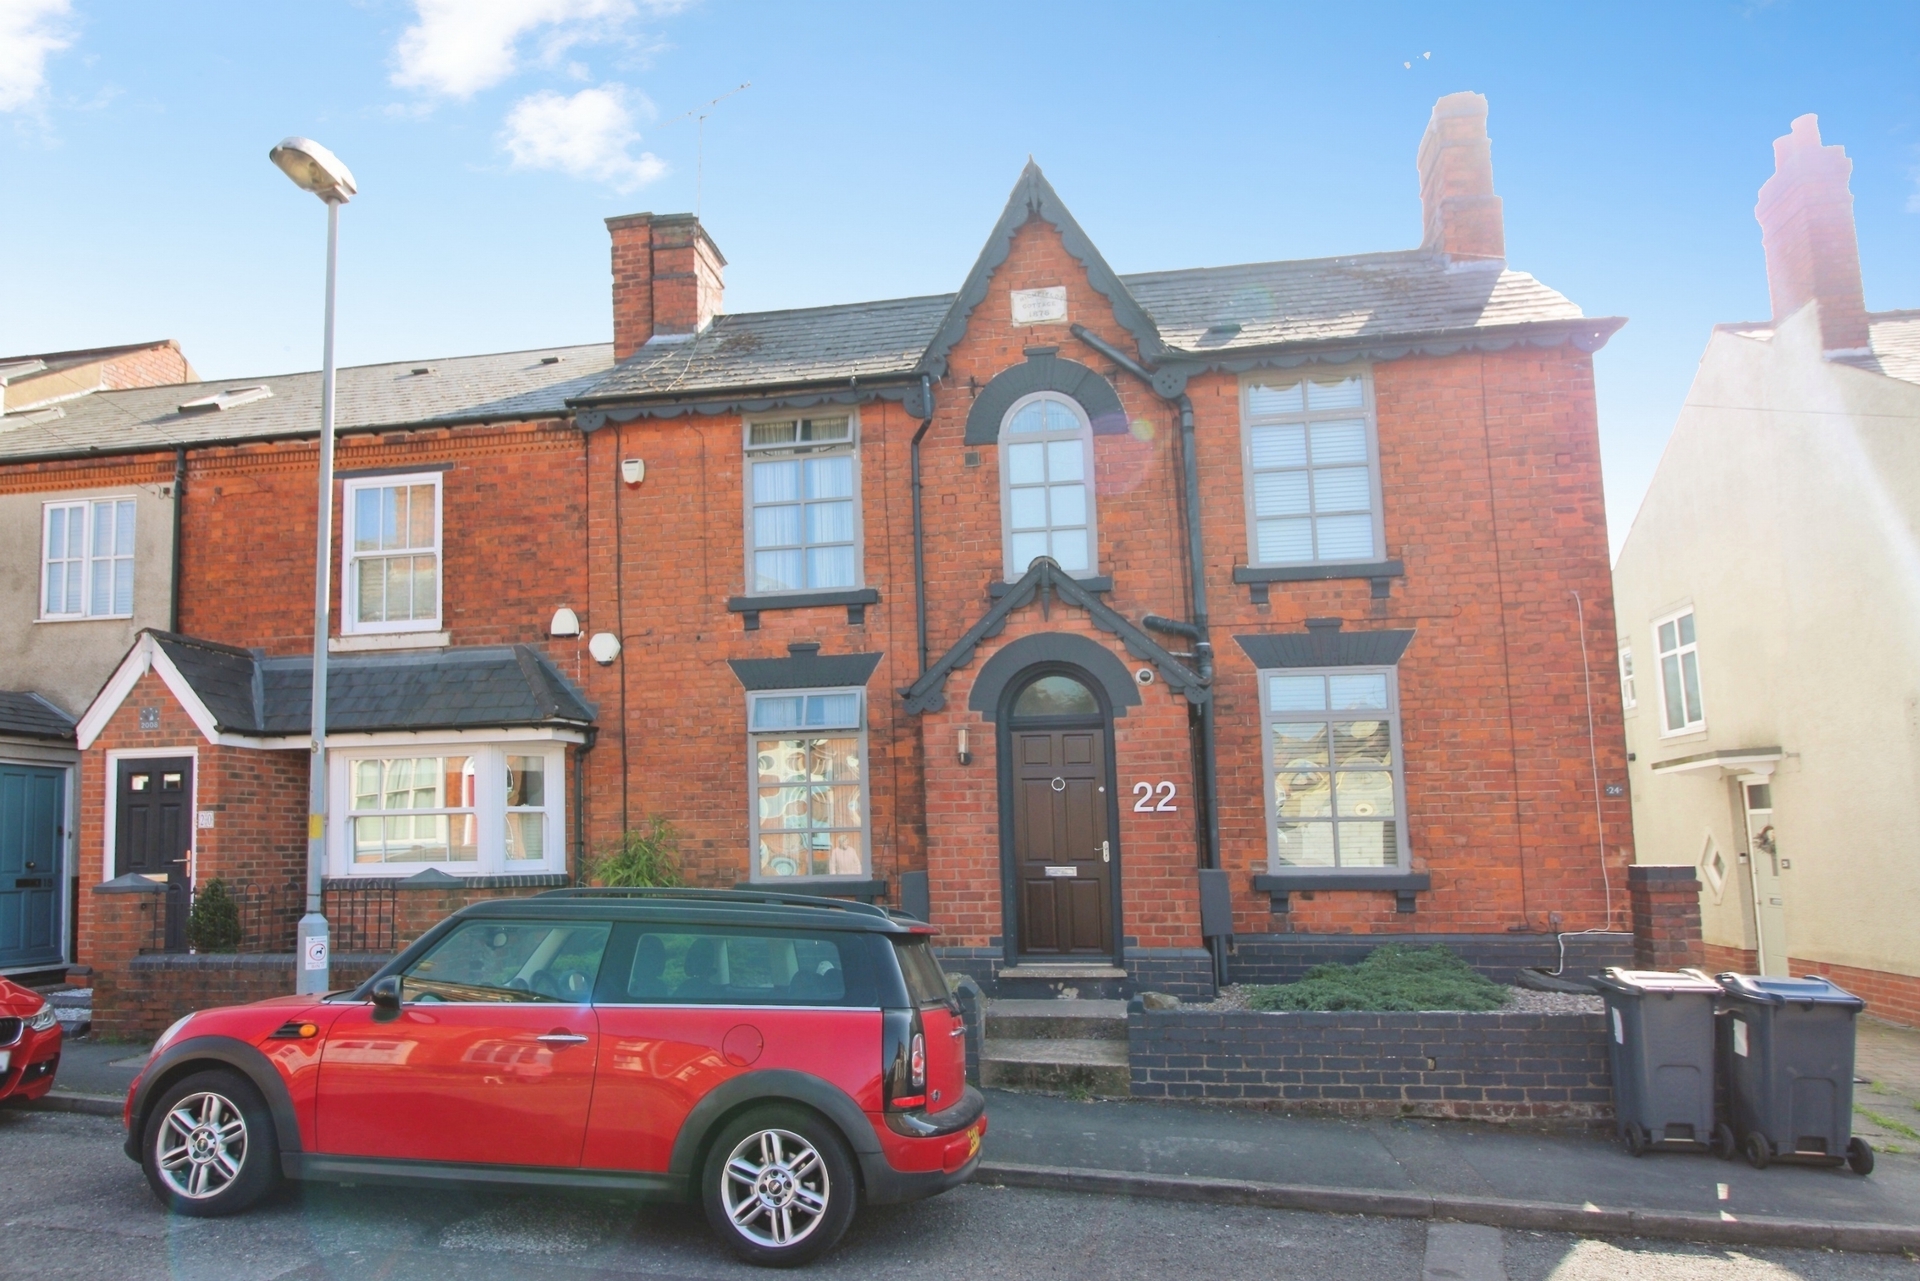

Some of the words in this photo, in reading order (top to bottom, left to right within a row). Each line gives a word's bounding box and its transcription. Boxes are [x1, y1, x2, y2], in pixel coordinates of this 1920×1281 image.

[1022, 301, 1056, 309] COTTAGE
[1133, 781, 1177, 812] 22
[200, 814, 212, 826] 20
